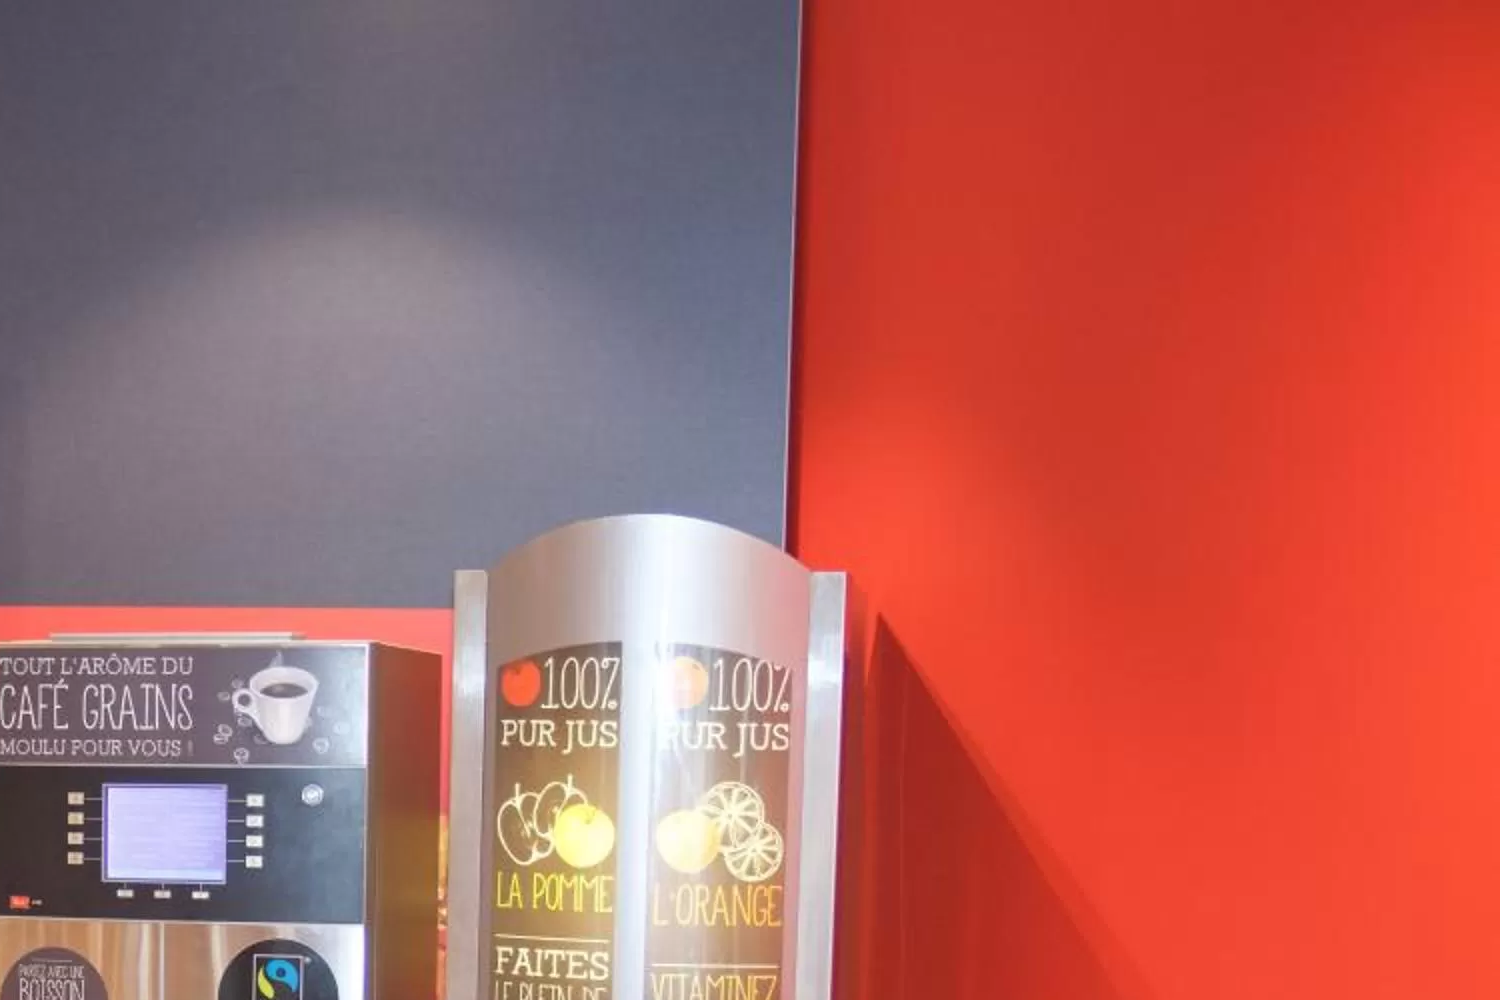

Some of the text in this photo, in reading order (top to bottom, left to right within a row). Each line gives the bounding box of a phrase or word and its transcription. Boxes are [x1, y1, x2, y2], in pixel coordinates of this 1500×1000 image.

[0, 652, 193, 676] TOUT L'ARÔME DU
[540, 656, 621, 711] 100%
[0, 679, 193, 731] CAFÉ GRAINS
[708, 657, 792, 714] 100%
[0, 738, 65, 756] MOULU
[71, 739, 123, 757] POUR
[126, 739, 181, 757] VOUS
[500, 719, 619, 756] PUR JUS
[733, 722, 791, 758] JUS
[496, 872, 613, 914] LA POMME
[651, 883, 783, 928] L'ORANGE
[495, 946, 610, 981] FAITES
